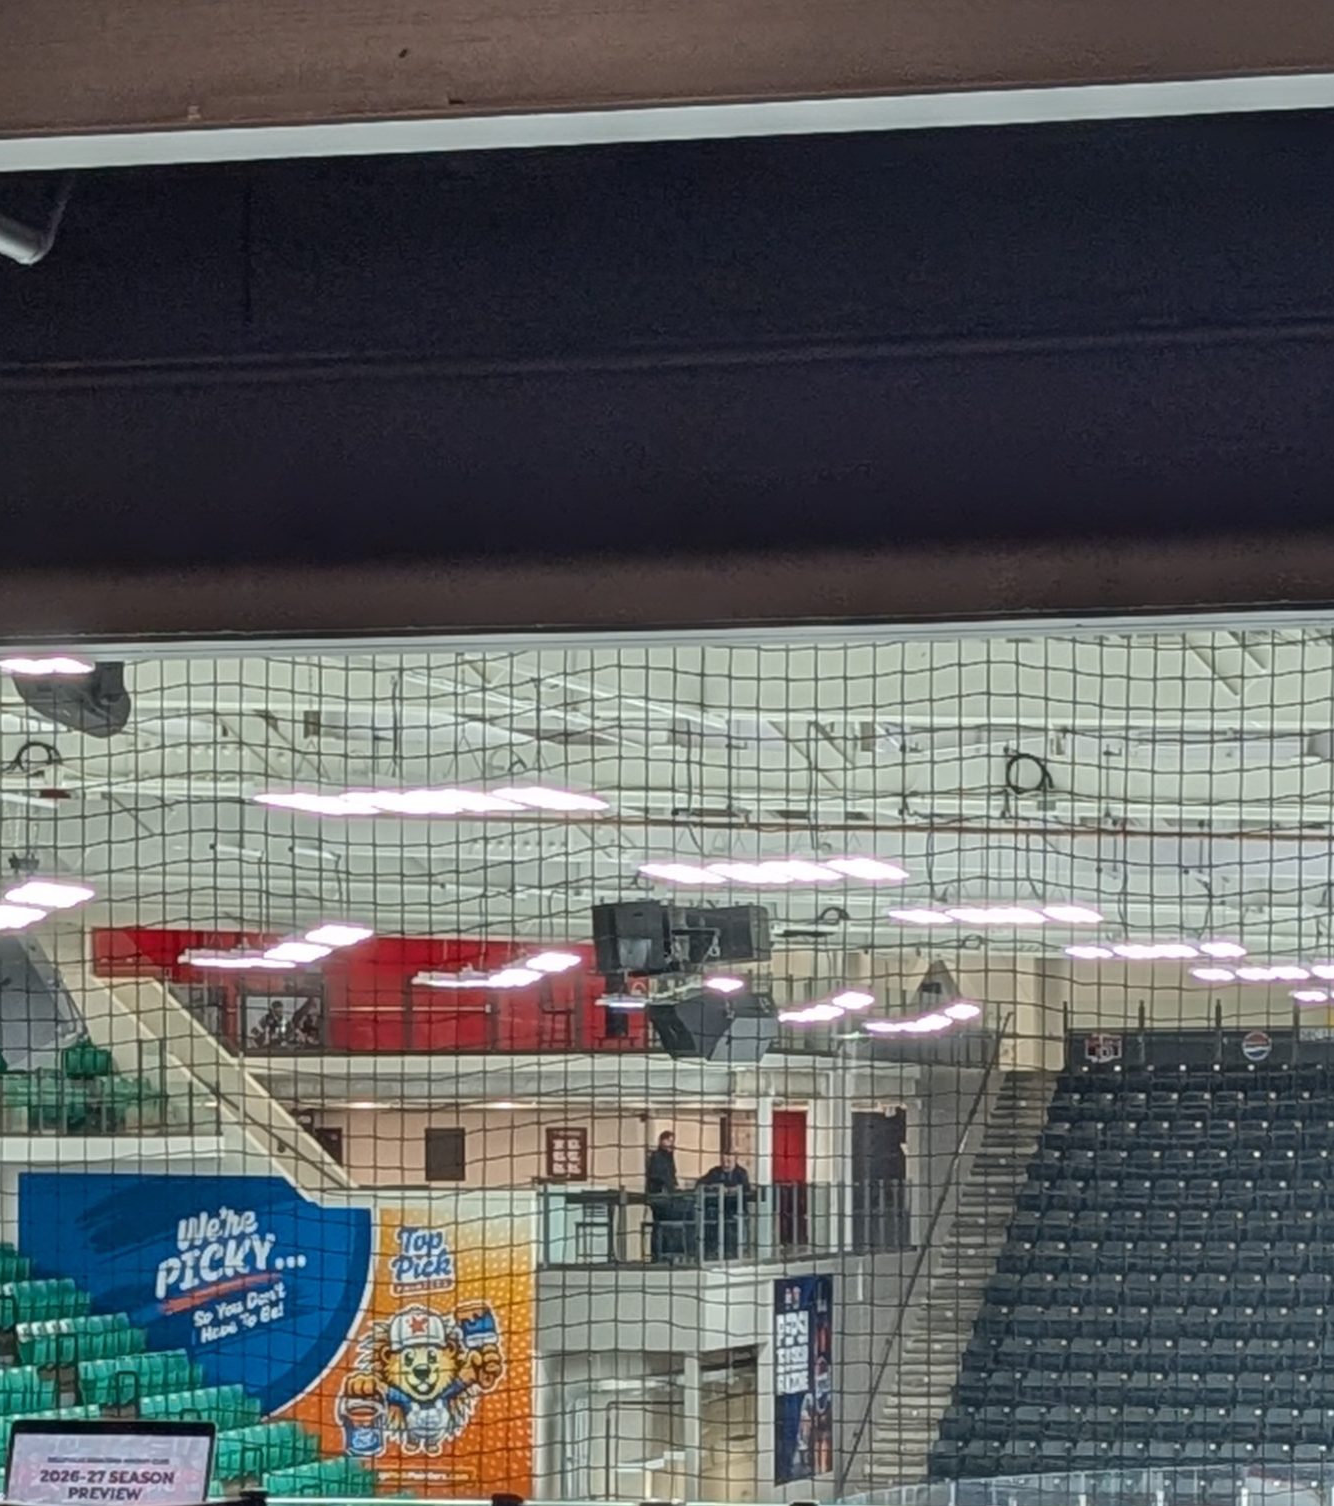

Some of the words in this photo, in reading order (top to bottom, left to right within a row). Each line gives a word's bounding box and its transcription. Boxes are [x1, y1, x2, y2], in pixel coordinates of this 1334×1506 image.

[177, 1206, 258, 1250] We're
[397, 1227, 444, 1253] Top
[392, 1249, 452, 1281] Pick
[193, 1310, 214, 1327] So
[218, 1301, 243, 1319] You
[40, 1470, 104, 1483] 2026-27
[108, 1471, 174, 1484] SEASON
[68, 1487, 142, 1500] PREVIEW
